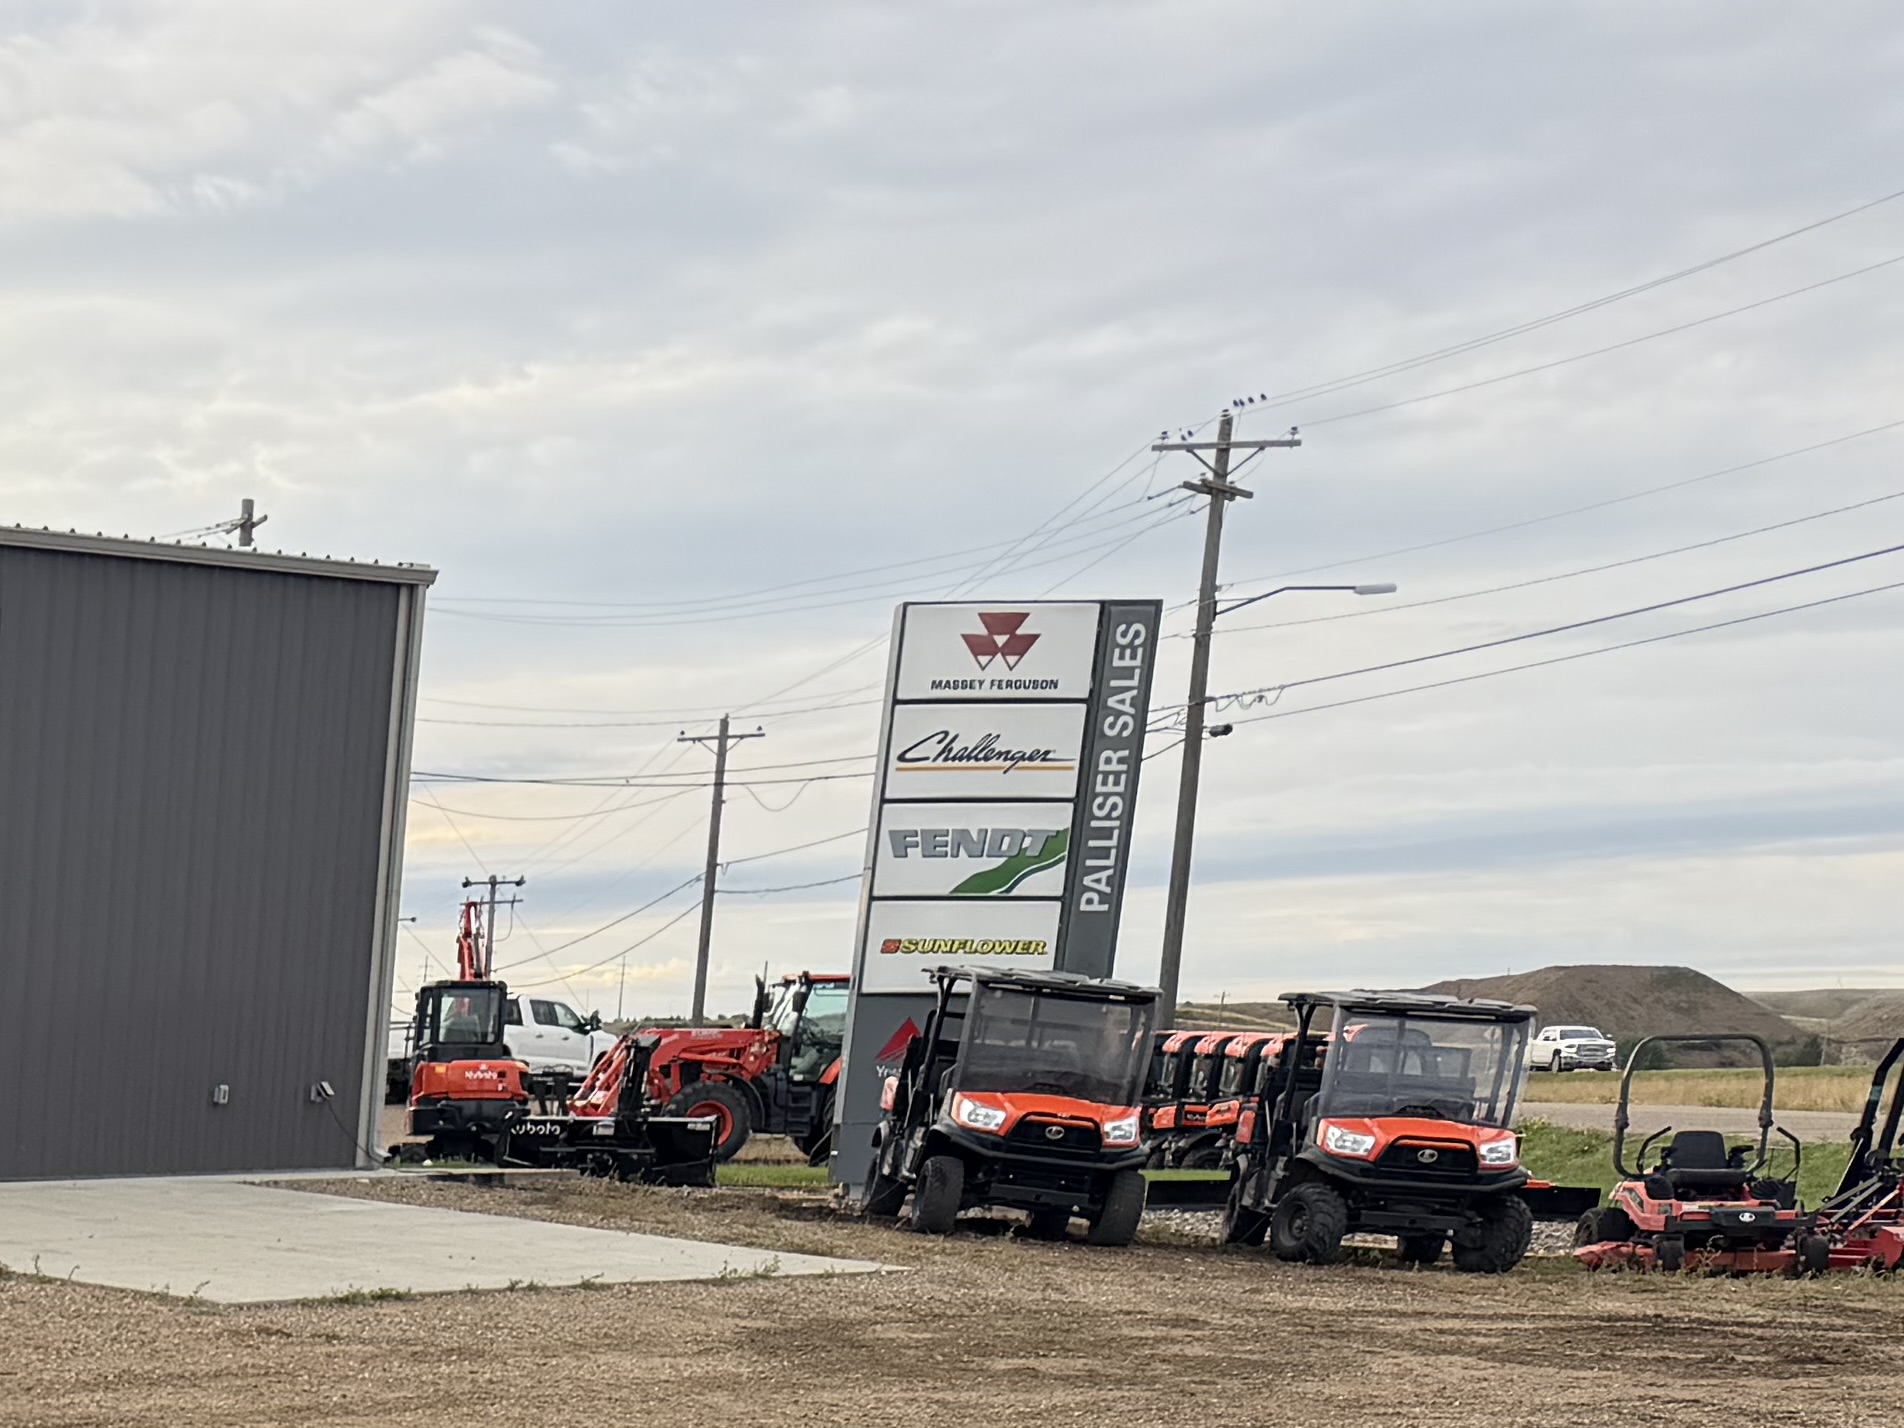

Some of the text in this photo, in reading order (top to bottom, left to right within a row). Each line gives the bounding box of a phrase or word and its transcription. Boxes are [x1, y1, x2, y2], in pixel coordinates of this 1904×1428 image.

[930, 679, 1059, 691] MASSEY FERGUSON
[896, 730, 1077, 775] Challenger
[1079, 621, 1146, 912] PALLISER SALES
[888, 828, 1058, 859] FENDT
[900, 938, 1048, 955] SUNFLOWER
